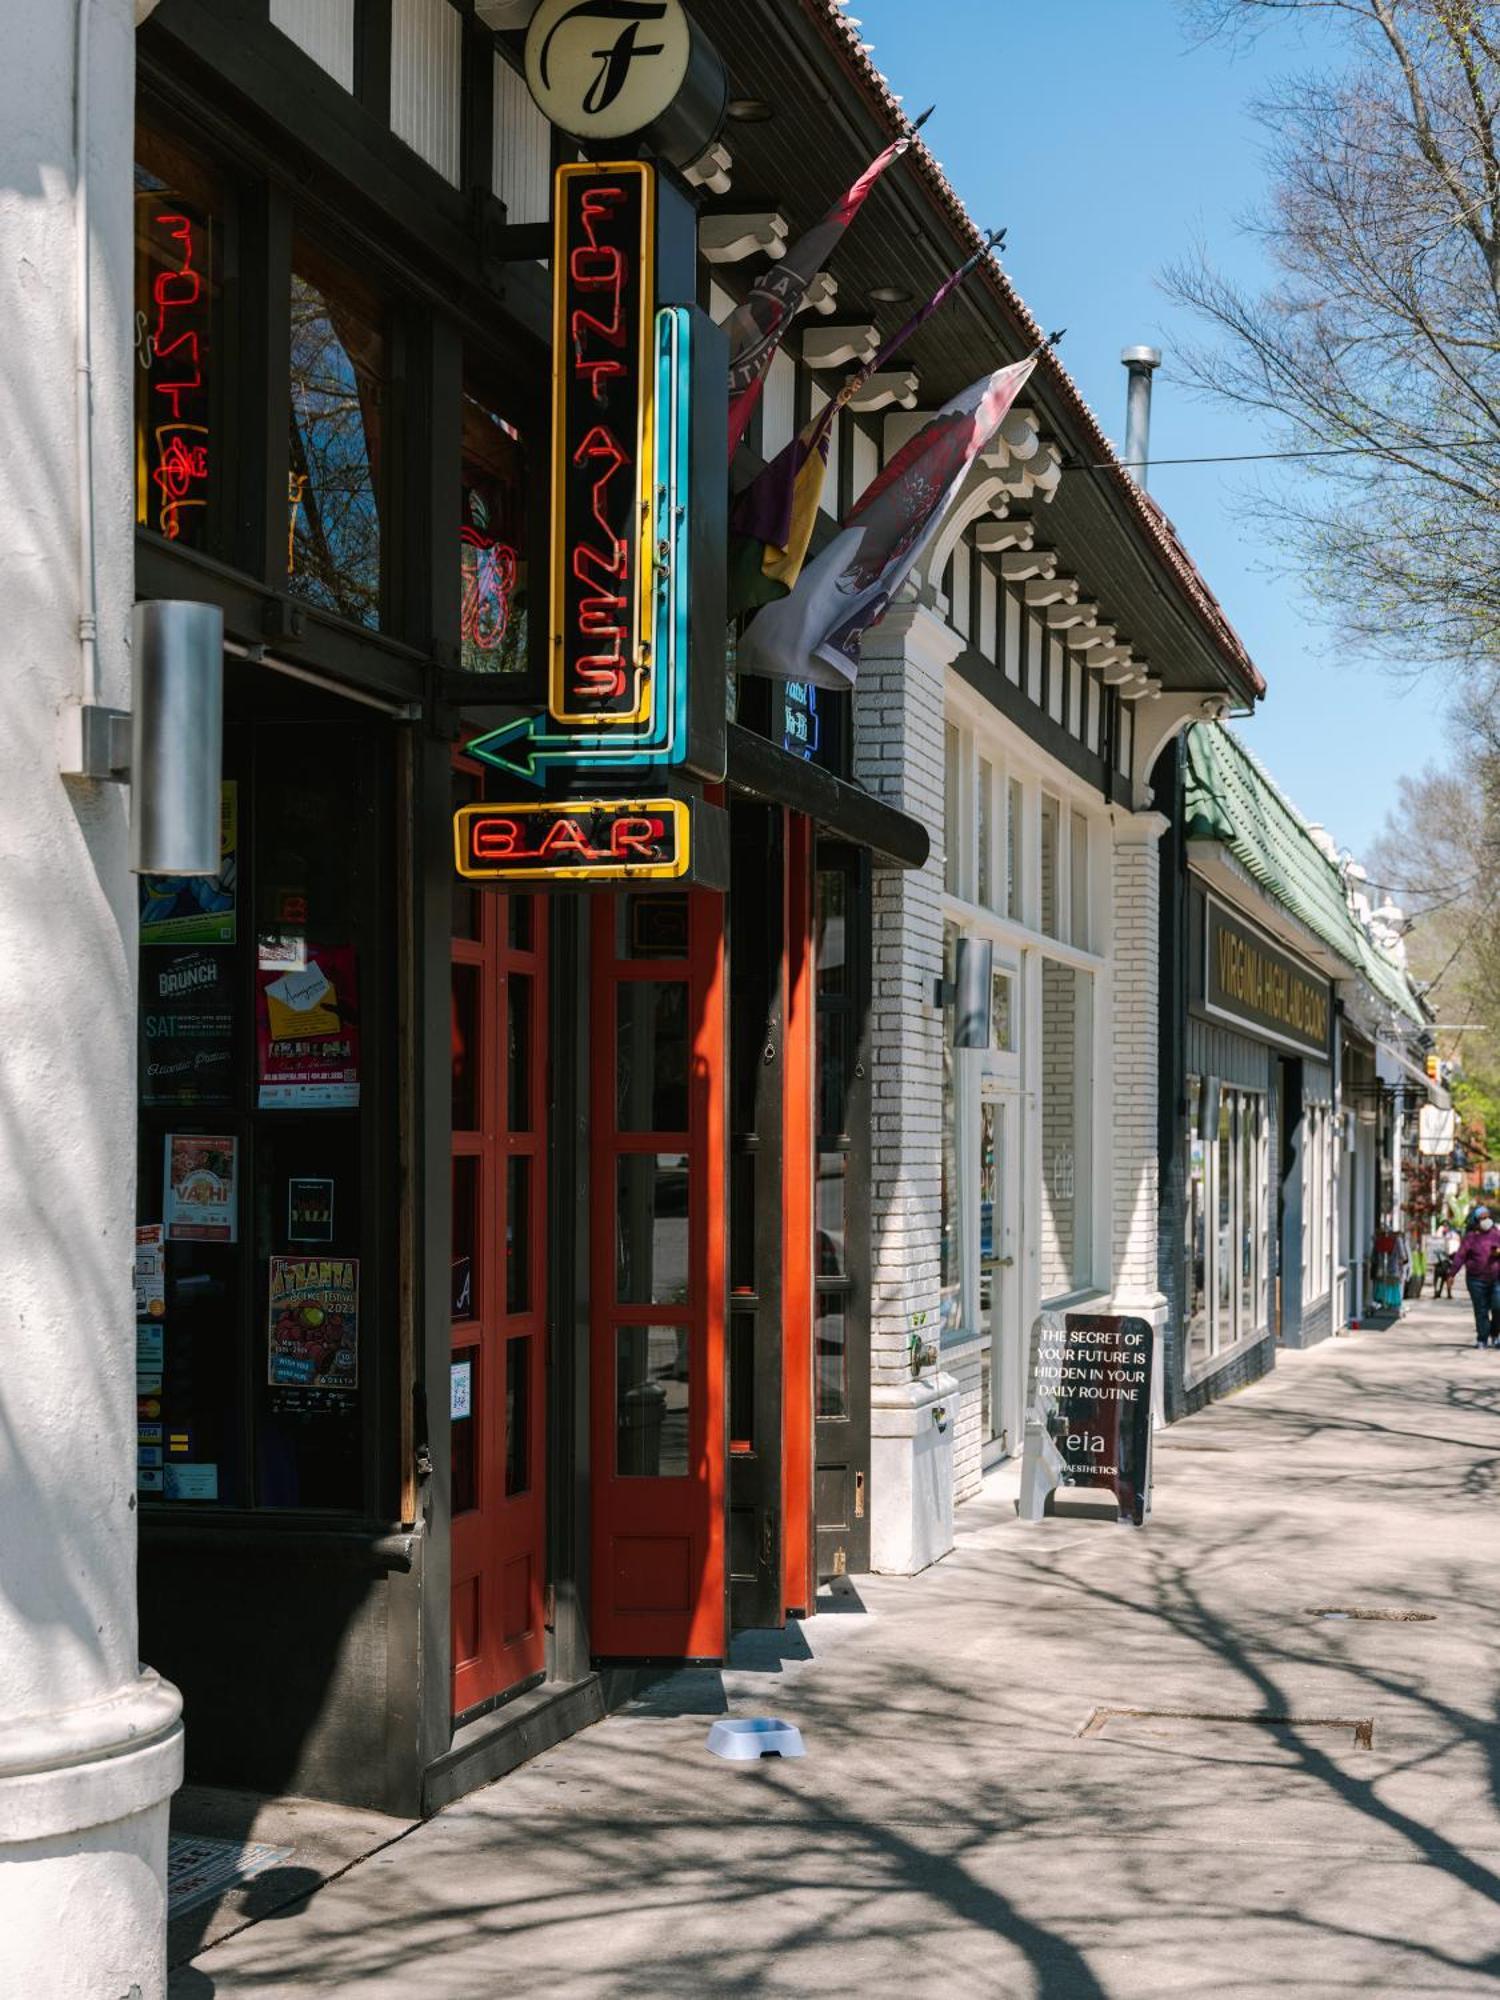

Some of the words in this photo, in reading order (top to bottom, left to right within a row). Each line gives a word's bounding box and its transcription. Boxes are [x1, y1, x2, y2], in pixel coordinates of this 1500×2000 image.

[571, 187, 631, 696] FONTAINES
[473, 818, 664, 860] BAR
[159, 963, 218, 997] BRUNCH
[146, 1015, 177, 1038] SAT
[327, 1303, 355, 1313] 2023
[1041, 1329, 1067, 1342] THE
[1070, 1331, 1121, 1345] SECRET
[1124, 1334, 1144, 1346] OF
[1037, 1348, 1075, 1361] YOUR
[1077, 1349, 1130, 1364] FUTURE
[1133, 1352, 1146, 1365] IS
[1034, 1366, 1087, 1380] HIDDEN
[1089, 1368, 1104, 1380] IN
[1106, 1370, 1145, 1383] YOUR
[1039, 1384, 1076, 1397] DAILY
[1079, 1386, 1139, 1401] ROUTINE
[1066, 1431, 1105, 1453] eia
